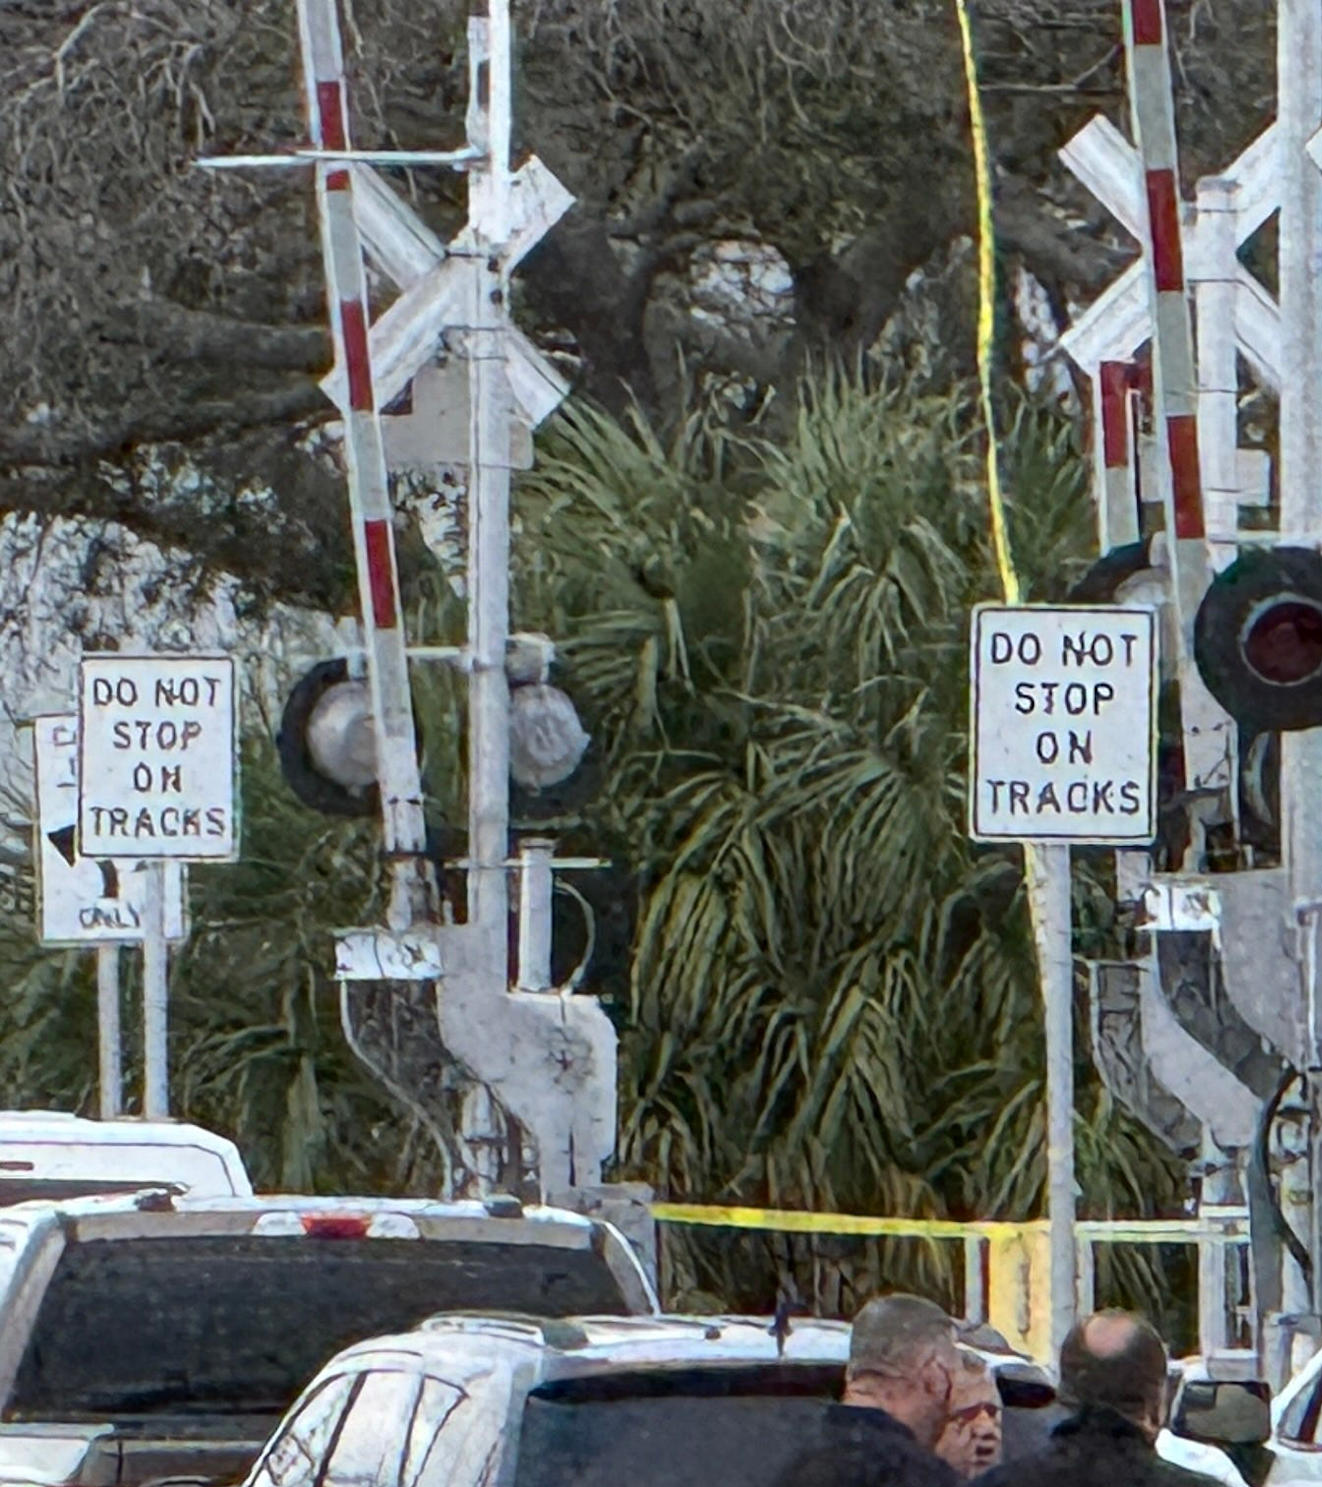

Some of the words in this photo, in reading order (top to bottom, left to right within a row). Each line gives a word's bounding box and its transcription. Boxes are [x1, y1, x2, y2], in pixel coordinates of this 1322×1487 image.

[990, 632, 1042, 666] DO
[1062, 631, 1138, 667] NOT
[93, 677, 138, 707] DO
[155, 678, 222, 707] NOT
[1015, 682, 1115, 716] STOP
[112, 720, 203, 751] STOP
[1035, 730, 1093, 766] ON
[132, 762, 182, 793] ON
[987, 780, 1141, 815] TRACKS
[89, 806, 227, 838] TRACKS
